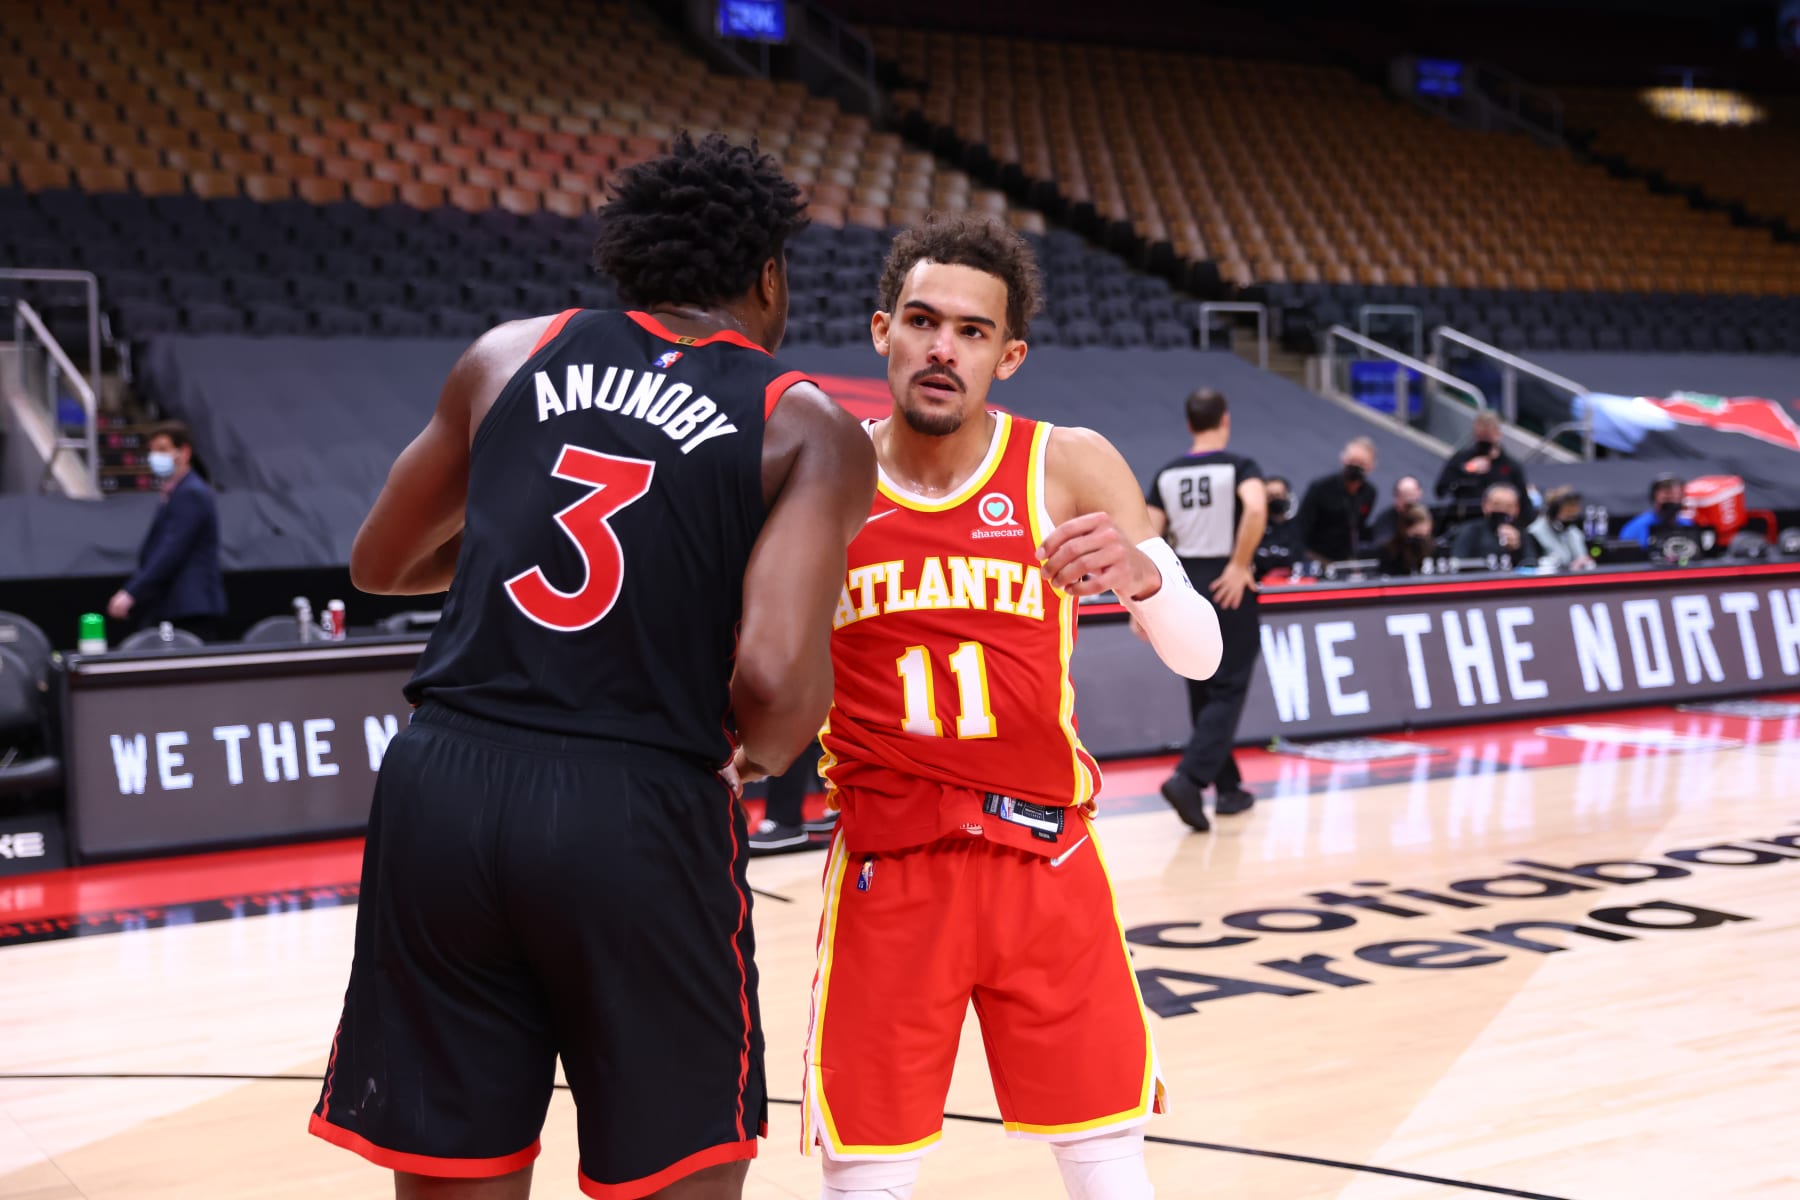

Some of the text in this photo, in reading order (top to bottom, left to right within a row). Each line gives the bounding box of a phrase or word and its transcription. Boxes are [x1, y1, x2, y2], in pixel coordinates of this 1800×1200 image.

[534, 363, 739, 455] ANUNOBY
[504, 444, 656, 632] 3
[971, 529, 1024, 539] sharecare
[1180, 476, 1212, 509] 29
[833, 556, 1045, 630] ATLANTA
[896, 641, 998, 740] 11
[1260, 588, 1800, 722] WE THE NORTH
[110, 730, 194, 795] WE
[213, 718, 340, 786] THE
[1126, 833, 1800, 956] cotiaba
[1135, 900, 1754, 1018] Arena
